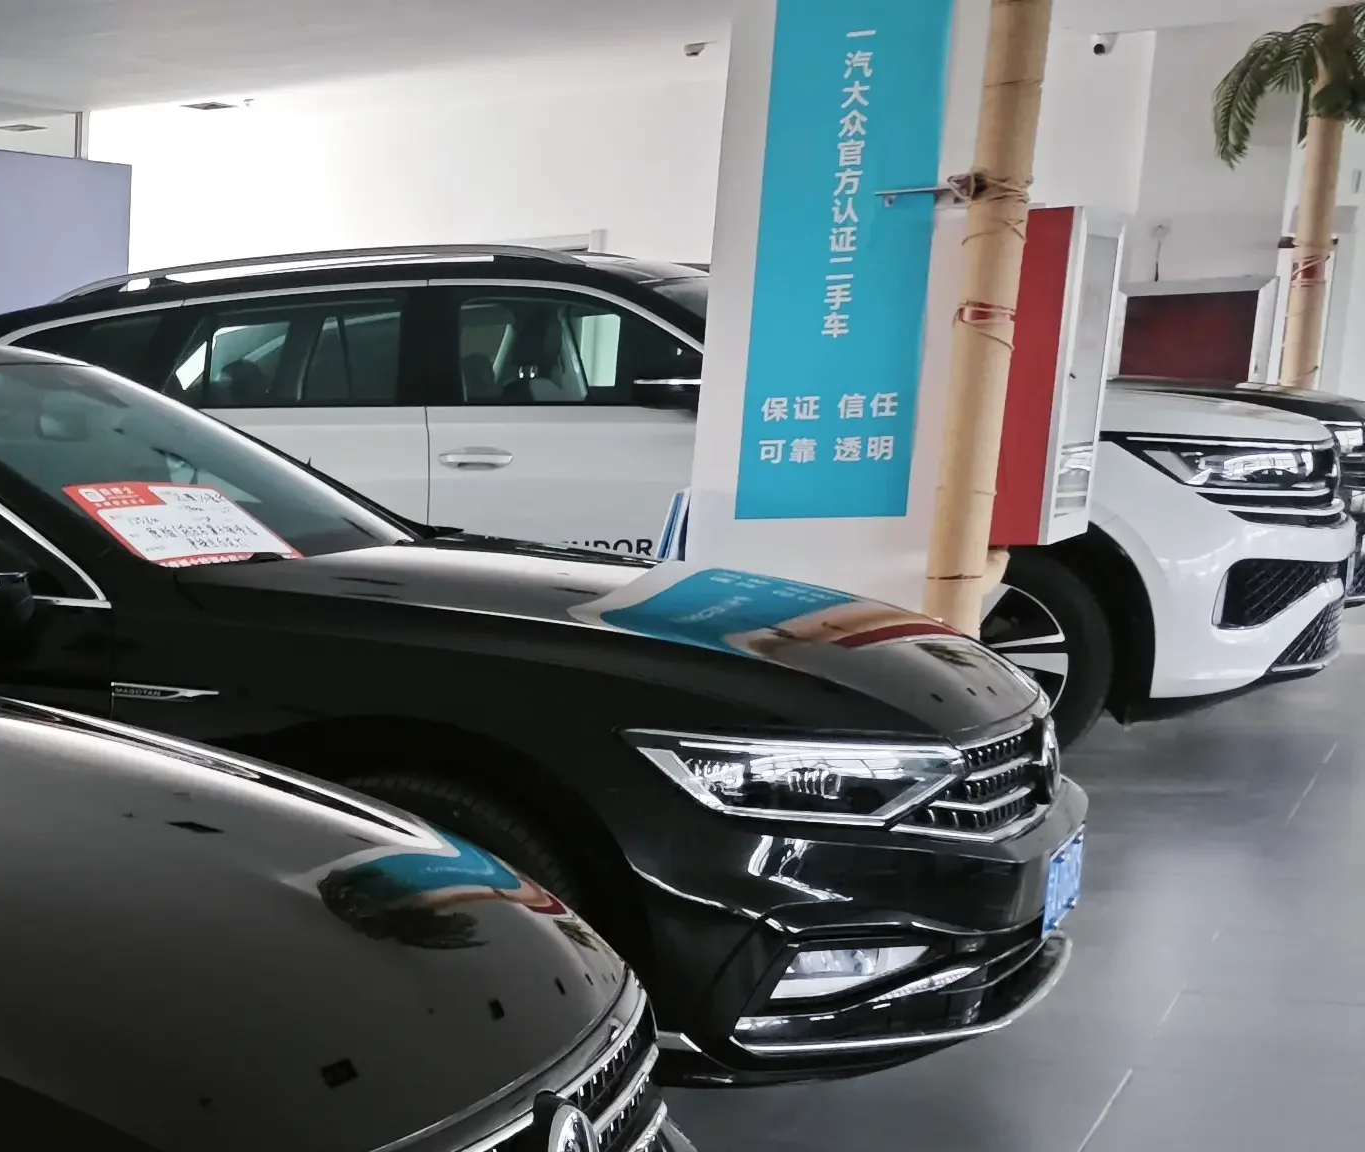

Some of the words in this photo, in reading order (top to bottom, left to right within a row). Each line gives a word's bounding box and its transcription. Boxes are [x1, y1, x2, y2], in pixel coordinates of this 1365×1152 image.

[821, 29, 877, 339] 一汽大众官方认证二手车
[761, 395, 821, 422] 保证
[838, 393, 899, 419] 信任
[759, 438, 817, 464] 可靠
[833, 436, 895, 462] 透明
